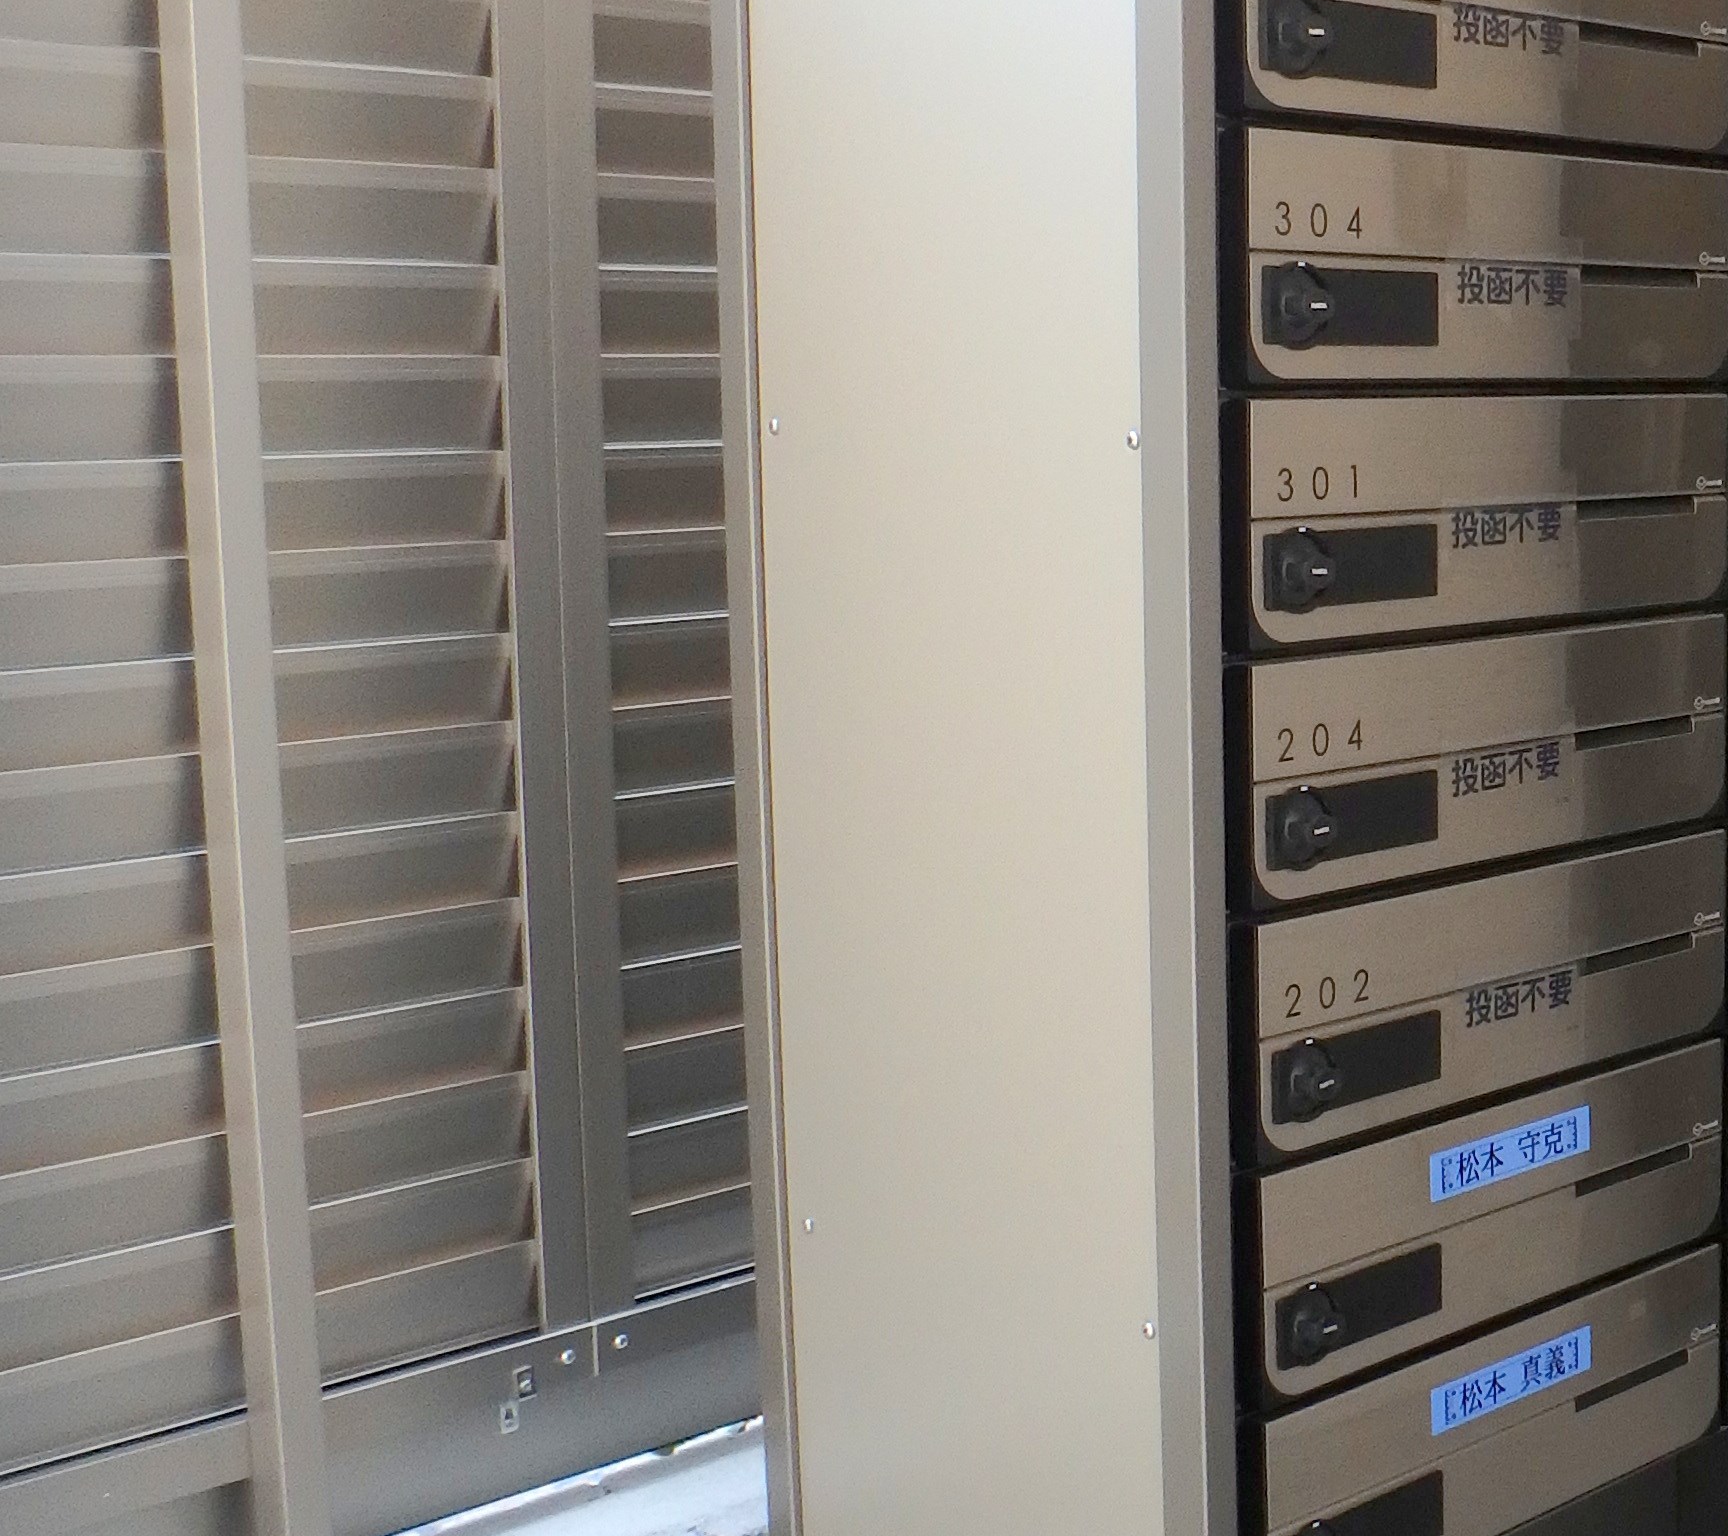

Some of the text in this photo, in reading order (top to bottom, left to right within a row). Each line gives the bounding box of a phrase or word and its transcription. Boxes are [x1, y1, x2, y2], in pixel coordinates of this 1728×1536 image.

[1453, 2, 1564, 56] 投函不要
[1275, 201, 1363, 239] 304
[1457, 265, 1567, 308] 投函不要
[1277, 464, 1360, 502] 301
[1452, 509, 1562, 548] 投函不要
[1277, 719, 1363, 762] 204
[1452, 741, 1560, 797] 投函不要
[1285, 968, 1369, 1018] 202
[1465, 968, 1573, 1028] 投函不要
[1456, 1142, 1504, 1186] 松本
[1460, 1370, 1507, 1416] 松本
